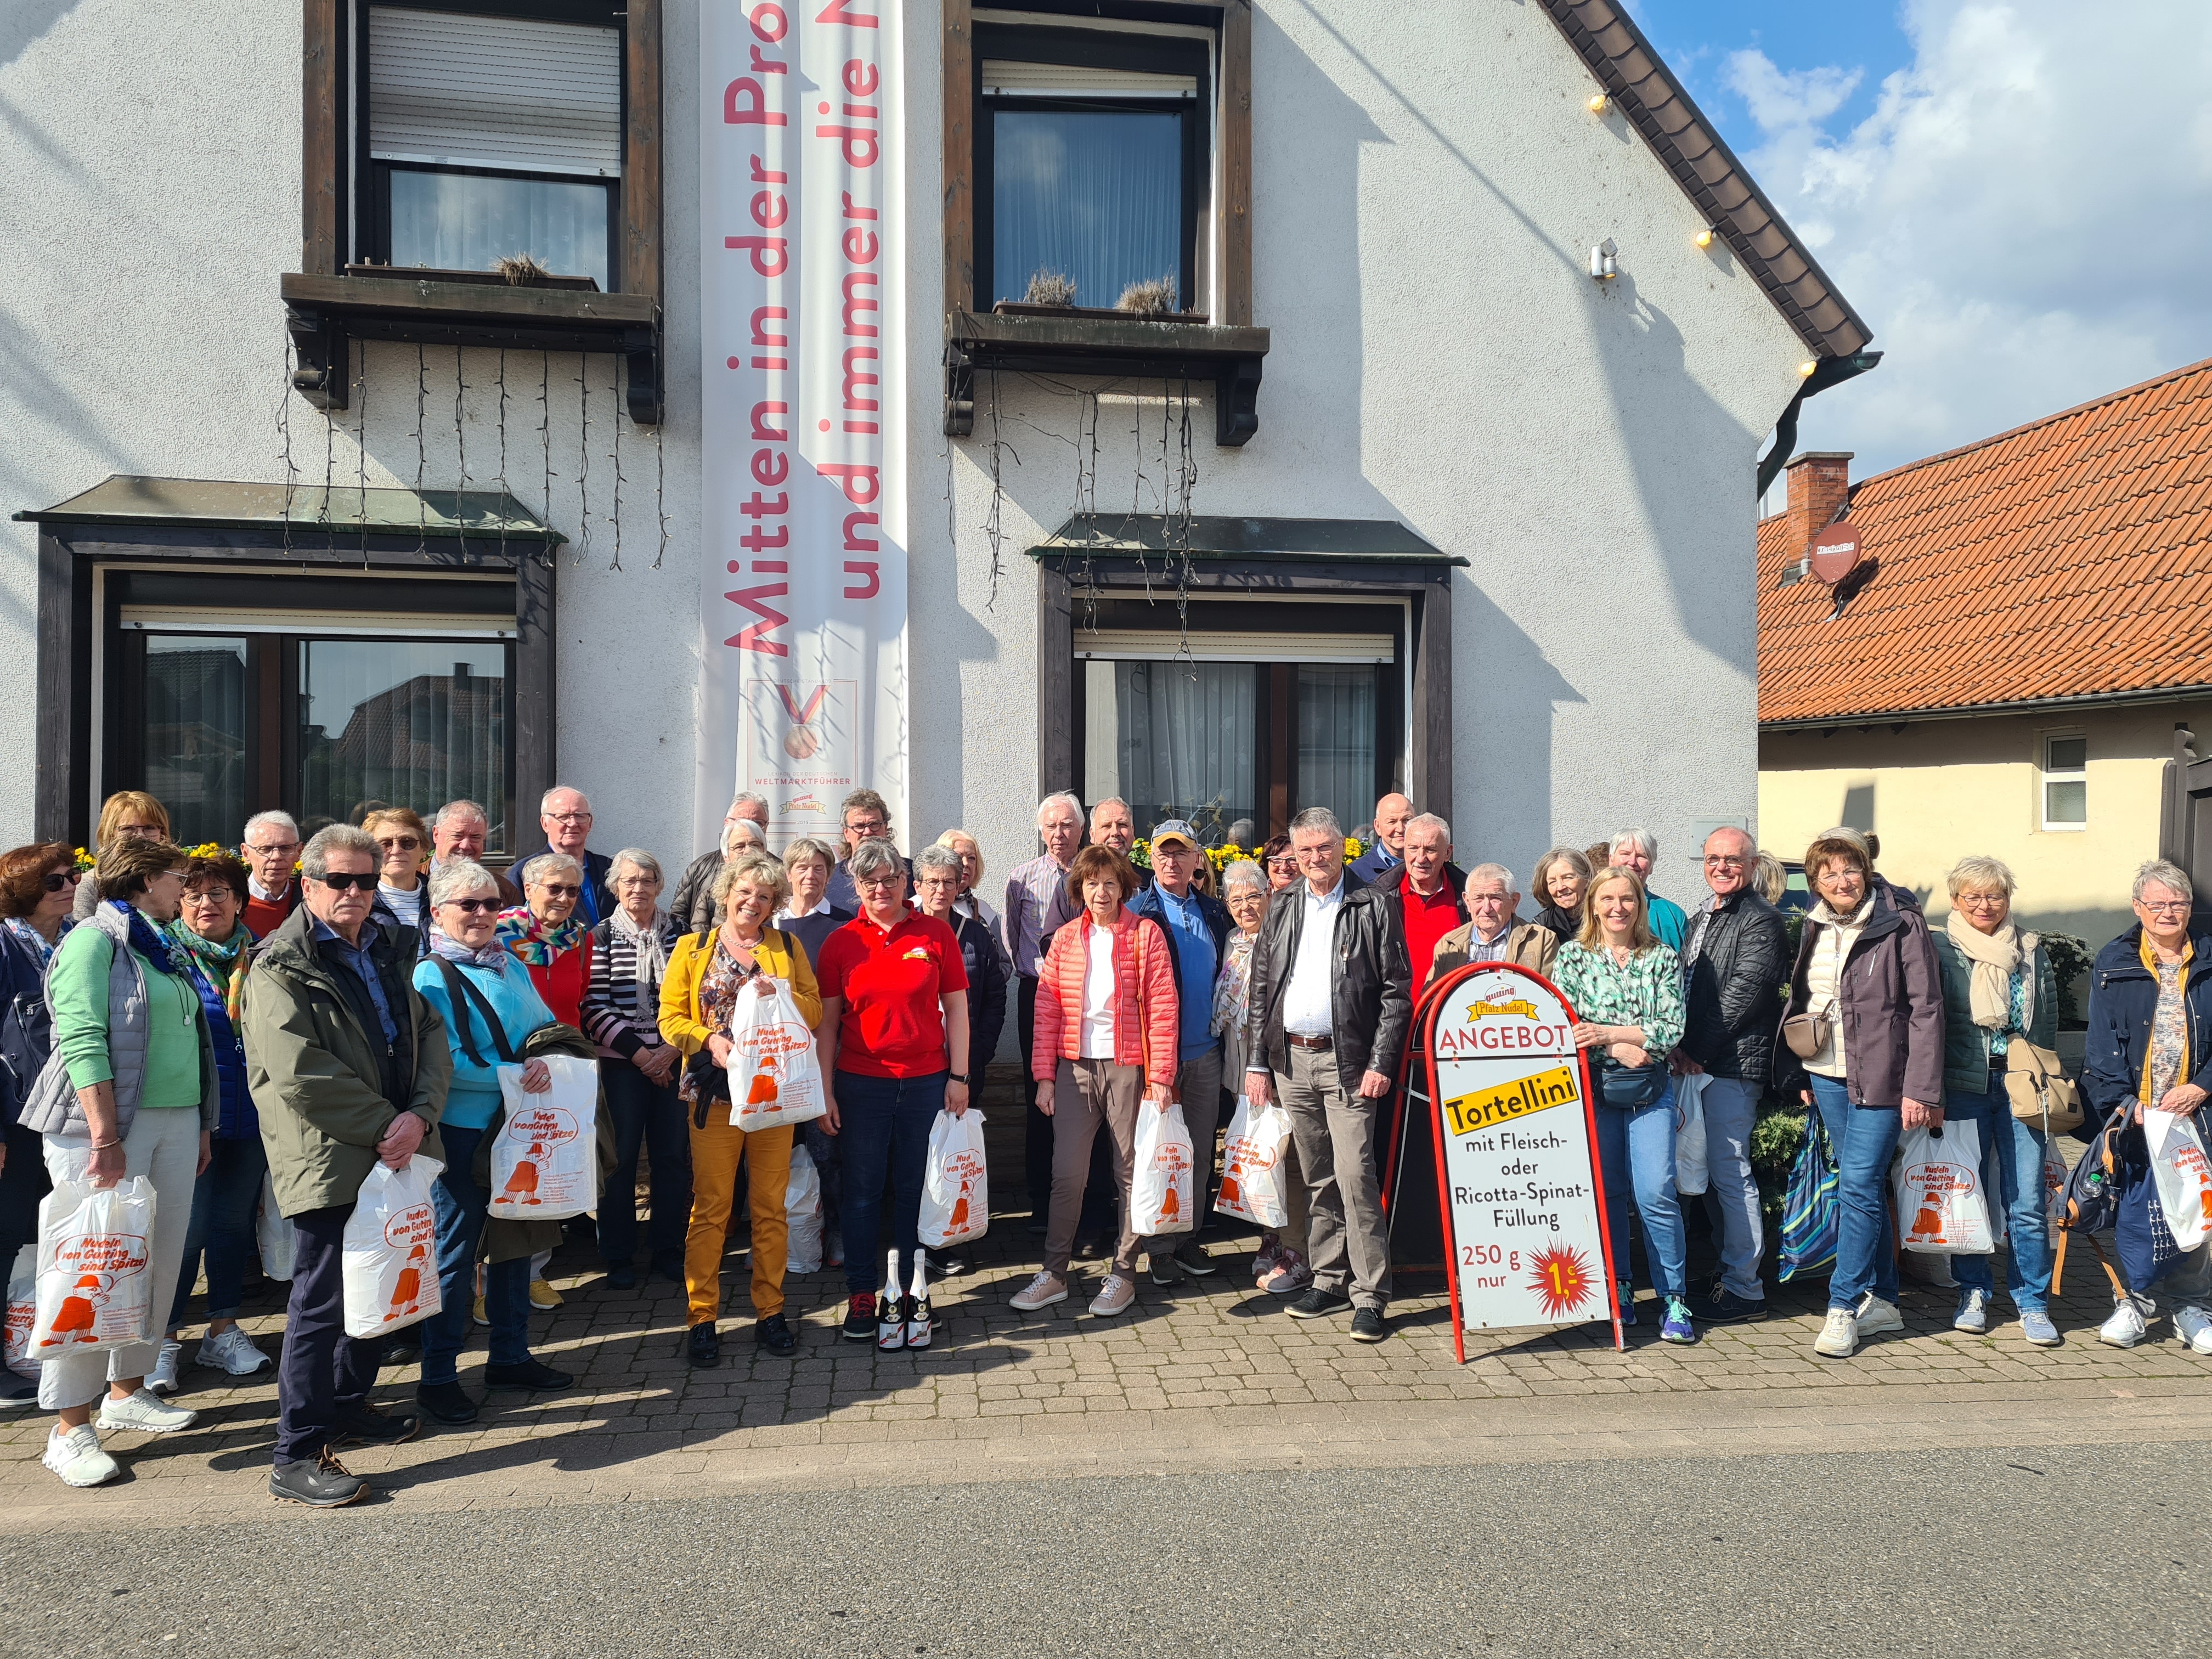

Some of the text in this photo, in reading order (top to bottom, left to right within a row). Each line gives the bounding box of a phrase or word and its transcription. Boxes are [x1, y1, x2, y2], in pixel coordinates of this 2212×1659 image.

[816, 59, 879, 168] die
[819, 192, 879, 435] immer
[725, 3, 788, 657] Mitten in der Pro
[816, 464, 879, 599] und
[1480, 1002, 1523, 1013] Pfalz Nudel
[757, 1026, 785, 1036] Nudeln
[761, 1035, 792, 1045] Gutting
[1440, 1025, 1567, 1051] ANGEBOT
[758, 1041, 807, 1054] sind Spitze
[1446, 1070, 1575, 1130] Tortellini
[514, 1122, 533, 1130] von
[1466, 1131, 1567, 1152] mit Fleisch-
[1248, 1157, 1271, 1167] Spitze
[1501, 1158, 1538, 1175] oder
[1924, 1165, 1949, 1173] Nudeln
[1926, 1174, 1956, 1183] Gutting
[1944, 1182, 1970, 1192] Spitze
[1455, 1182, 1589, 1206] Ricotta-Spinat-
[1493, 1208, 1560, 1232] Füllung
[393, 1225, 410, 1236] von
[410, 1229, 428, 1243] sind
[81, 1238, 121, 1248] Nudeln
[61, 1249, 128, 1261] von Gutting
[1462, 1244, 1521, 1271] 250 g
[78, 1257, 144, 1272] sind Spitze
[1477, 1276, 1507, 1288] nur
